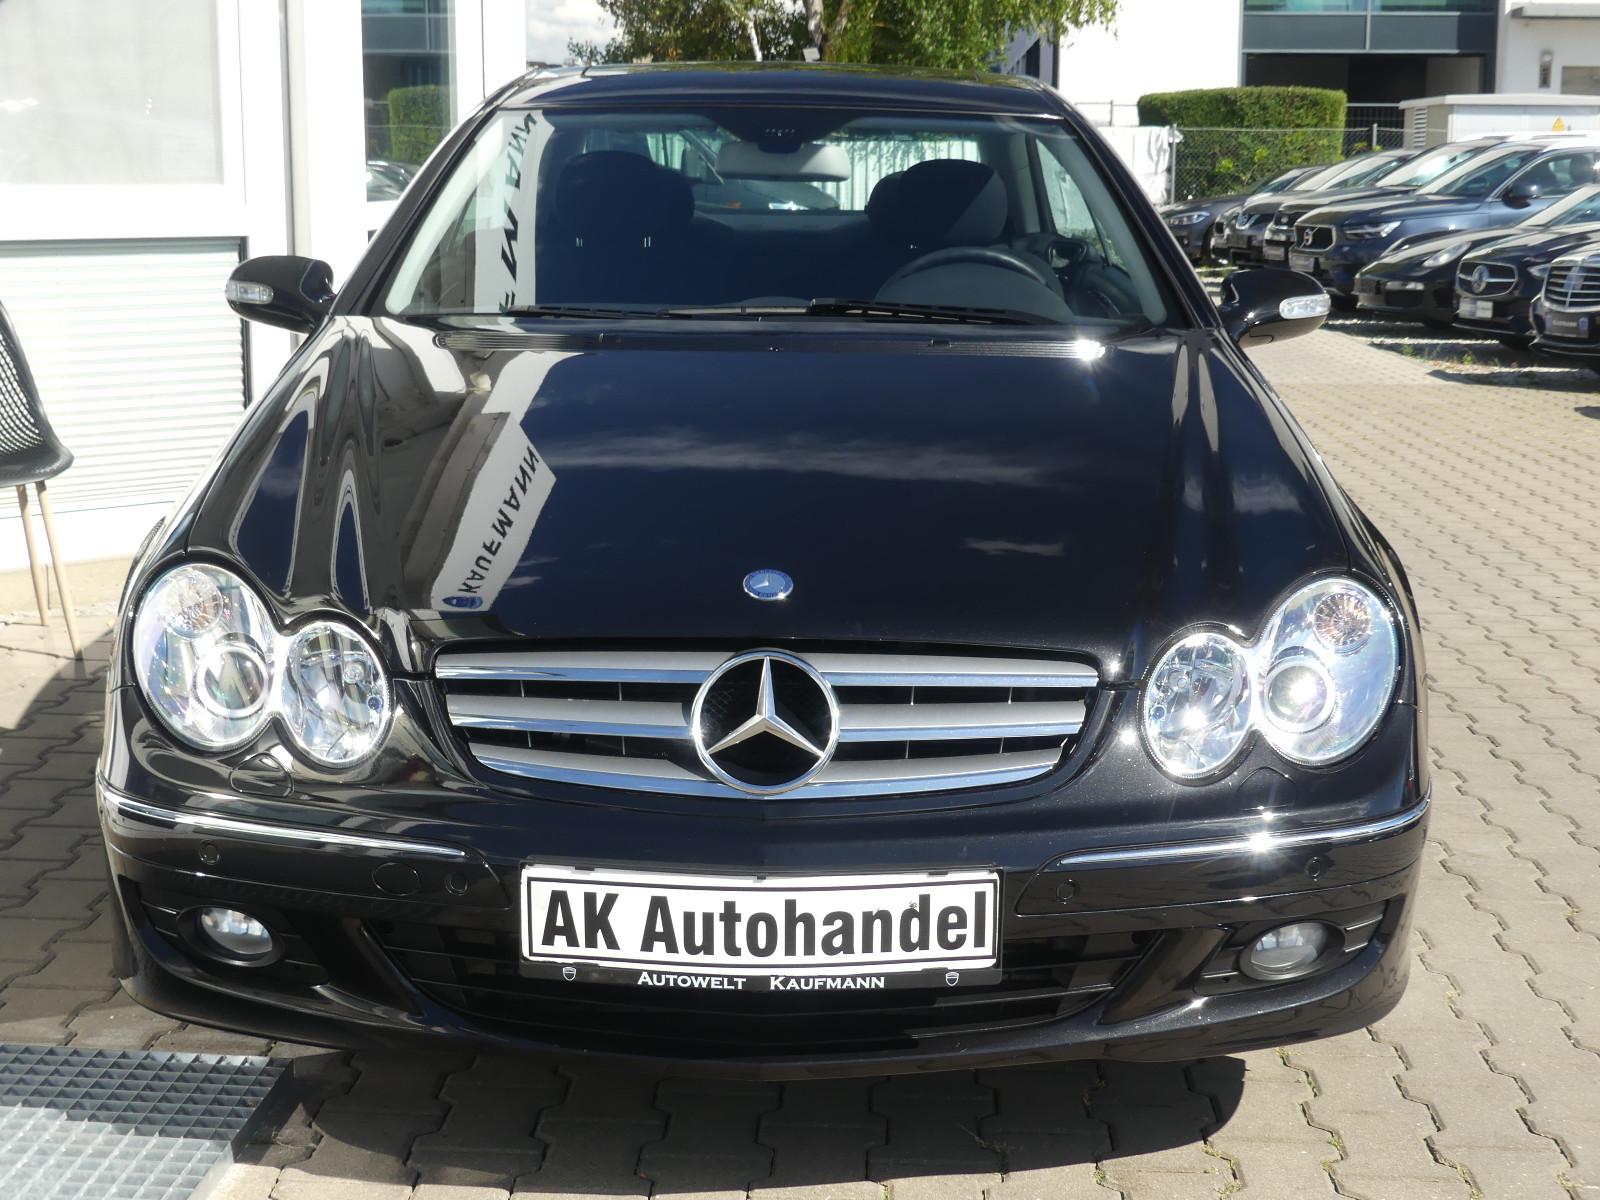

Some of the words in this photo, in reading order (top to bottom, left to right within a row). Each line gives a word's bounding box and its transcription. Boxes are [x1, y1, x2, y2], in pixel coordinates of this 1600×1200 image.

[541, 889, 622, 951] AK
[639, 890, 988, 958] Autohandel
[636, 971, 747, 990] AUTOWELT
[769, 975, 886, 991] KAUFMANN
